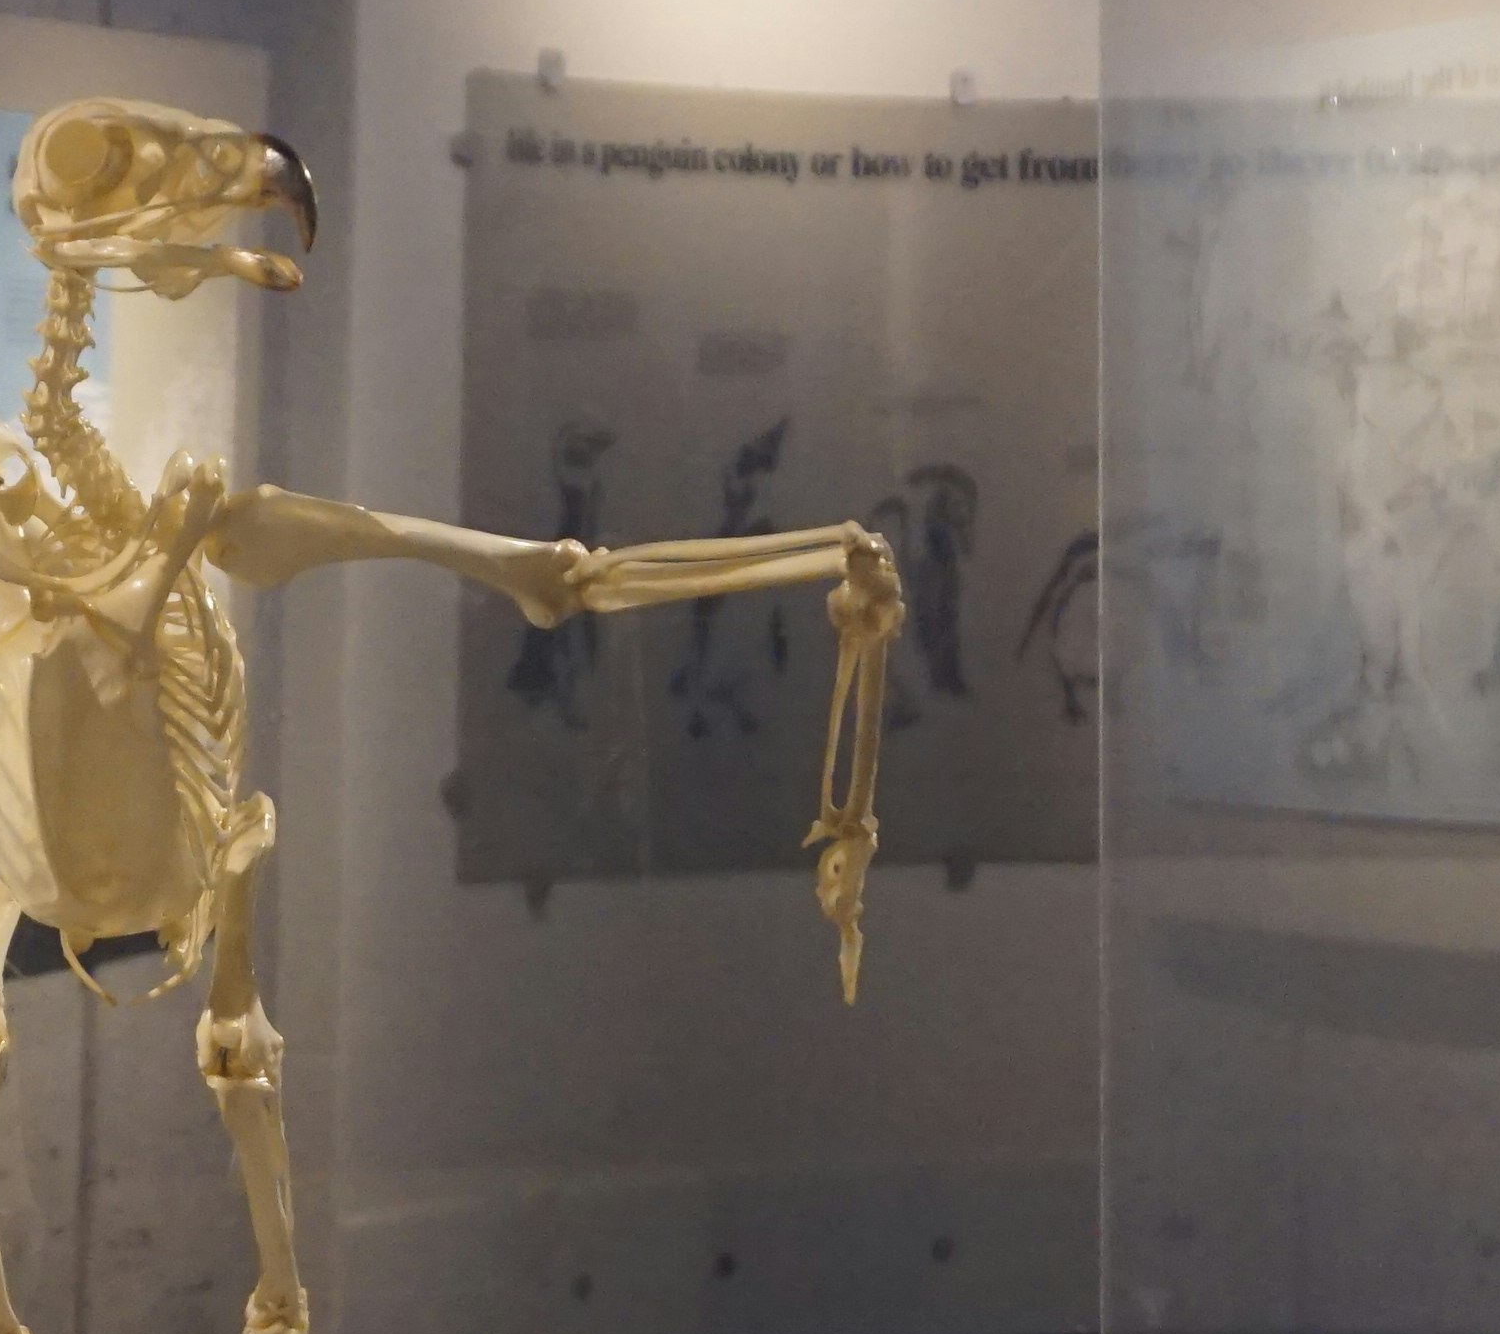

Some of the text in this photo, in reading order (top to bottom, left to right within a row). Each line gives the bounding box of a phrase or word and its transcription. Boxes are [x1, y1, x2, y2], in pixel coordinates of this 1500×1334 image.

[601, 136, 707, 180] penguin
[714, 142, 798, 183] colony
[811, 151, 842, 178] or
[852, 144, 910, 180] how
[923, 151, 954, 180] to
[961, 149, 1008, 189] get
[1019, 146, 1097, 184] from
